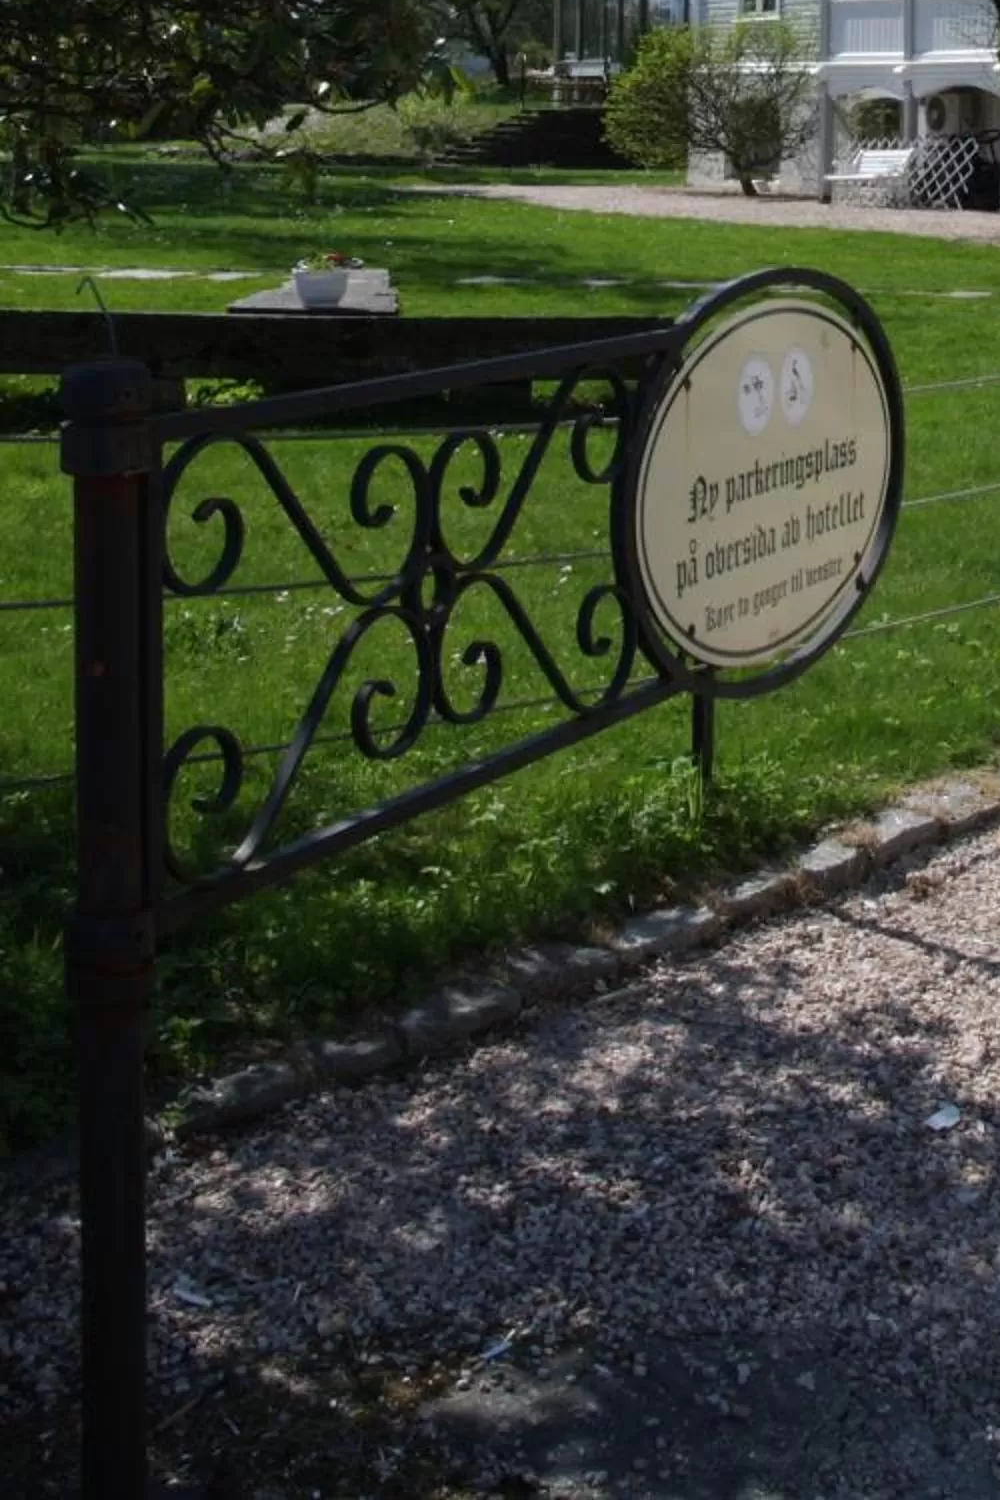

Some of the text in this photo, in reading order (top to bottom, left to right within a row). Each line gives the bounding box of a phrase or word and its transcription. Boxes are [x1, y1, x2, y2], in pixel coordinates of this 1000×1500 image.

[687, 436, 857, 522] Ny parkeringsplass
[676, 491, 865, 598] på oversida av hotellet
